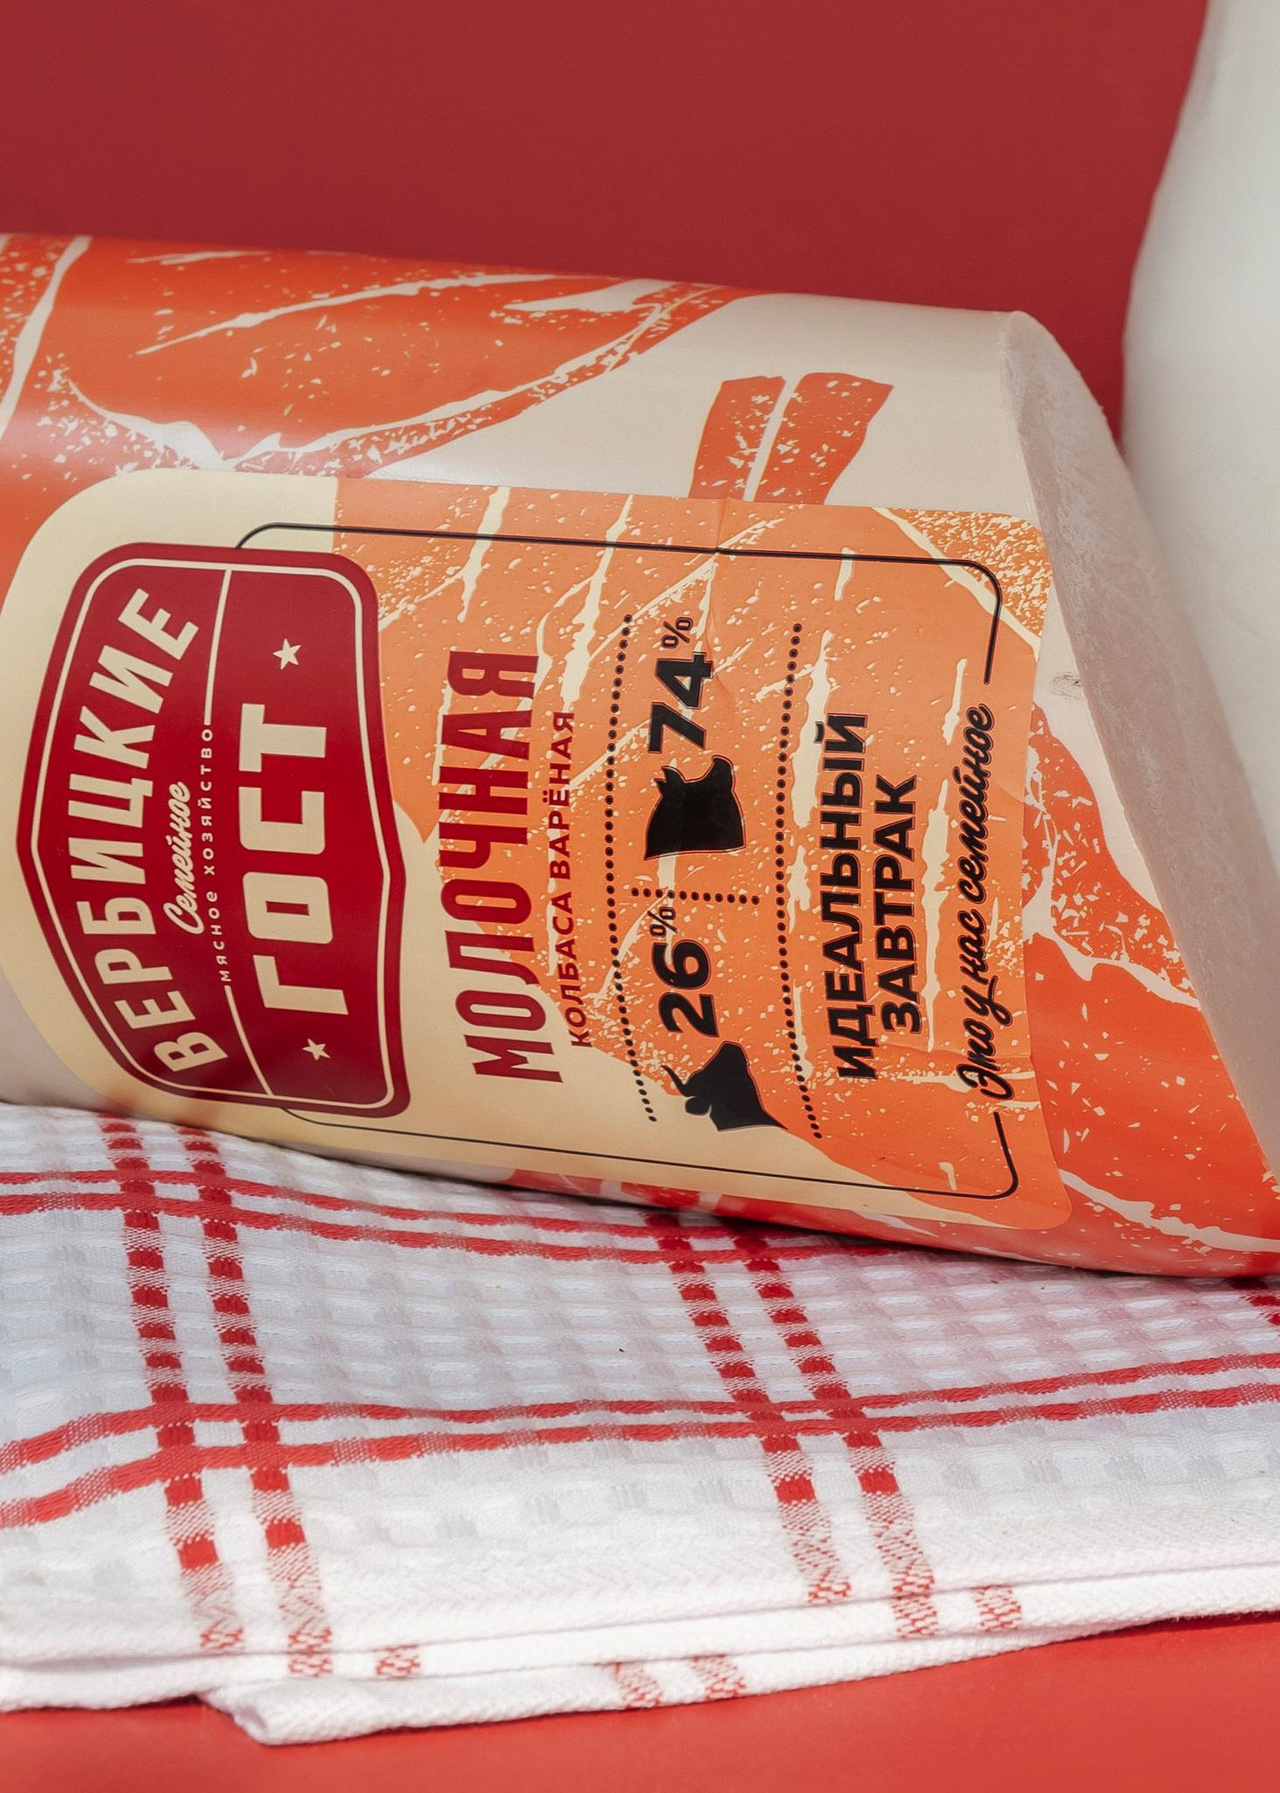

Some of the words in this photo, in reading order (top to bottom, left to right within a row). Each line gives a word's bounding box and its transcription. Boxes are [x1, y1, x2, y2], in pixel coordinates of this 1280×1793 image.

[67, 588, 229, 1073] ВЕРБИЦКИЕ
[162, 781, 205, 936] Семейное
[238, 703, 350, 1016] ГОСТ
[438, 650, 565, 1084] МОЛОЧНАЯ
[543, 711, 575, 881] ВАРЁНАЯ
[953, 702, 995, 905] семейное
[547, 892, 593, 1048] КОЛБАСА
[814, 713, 880, 1080] ИДЕАЛЬНЫЙ
[873, 775, 922, 1034] ЗАВТРАК
[959, 909, 988, 982] нас
[956, 1015, 1015, 1101] Это
[963, 975, 1013, 1027] у
